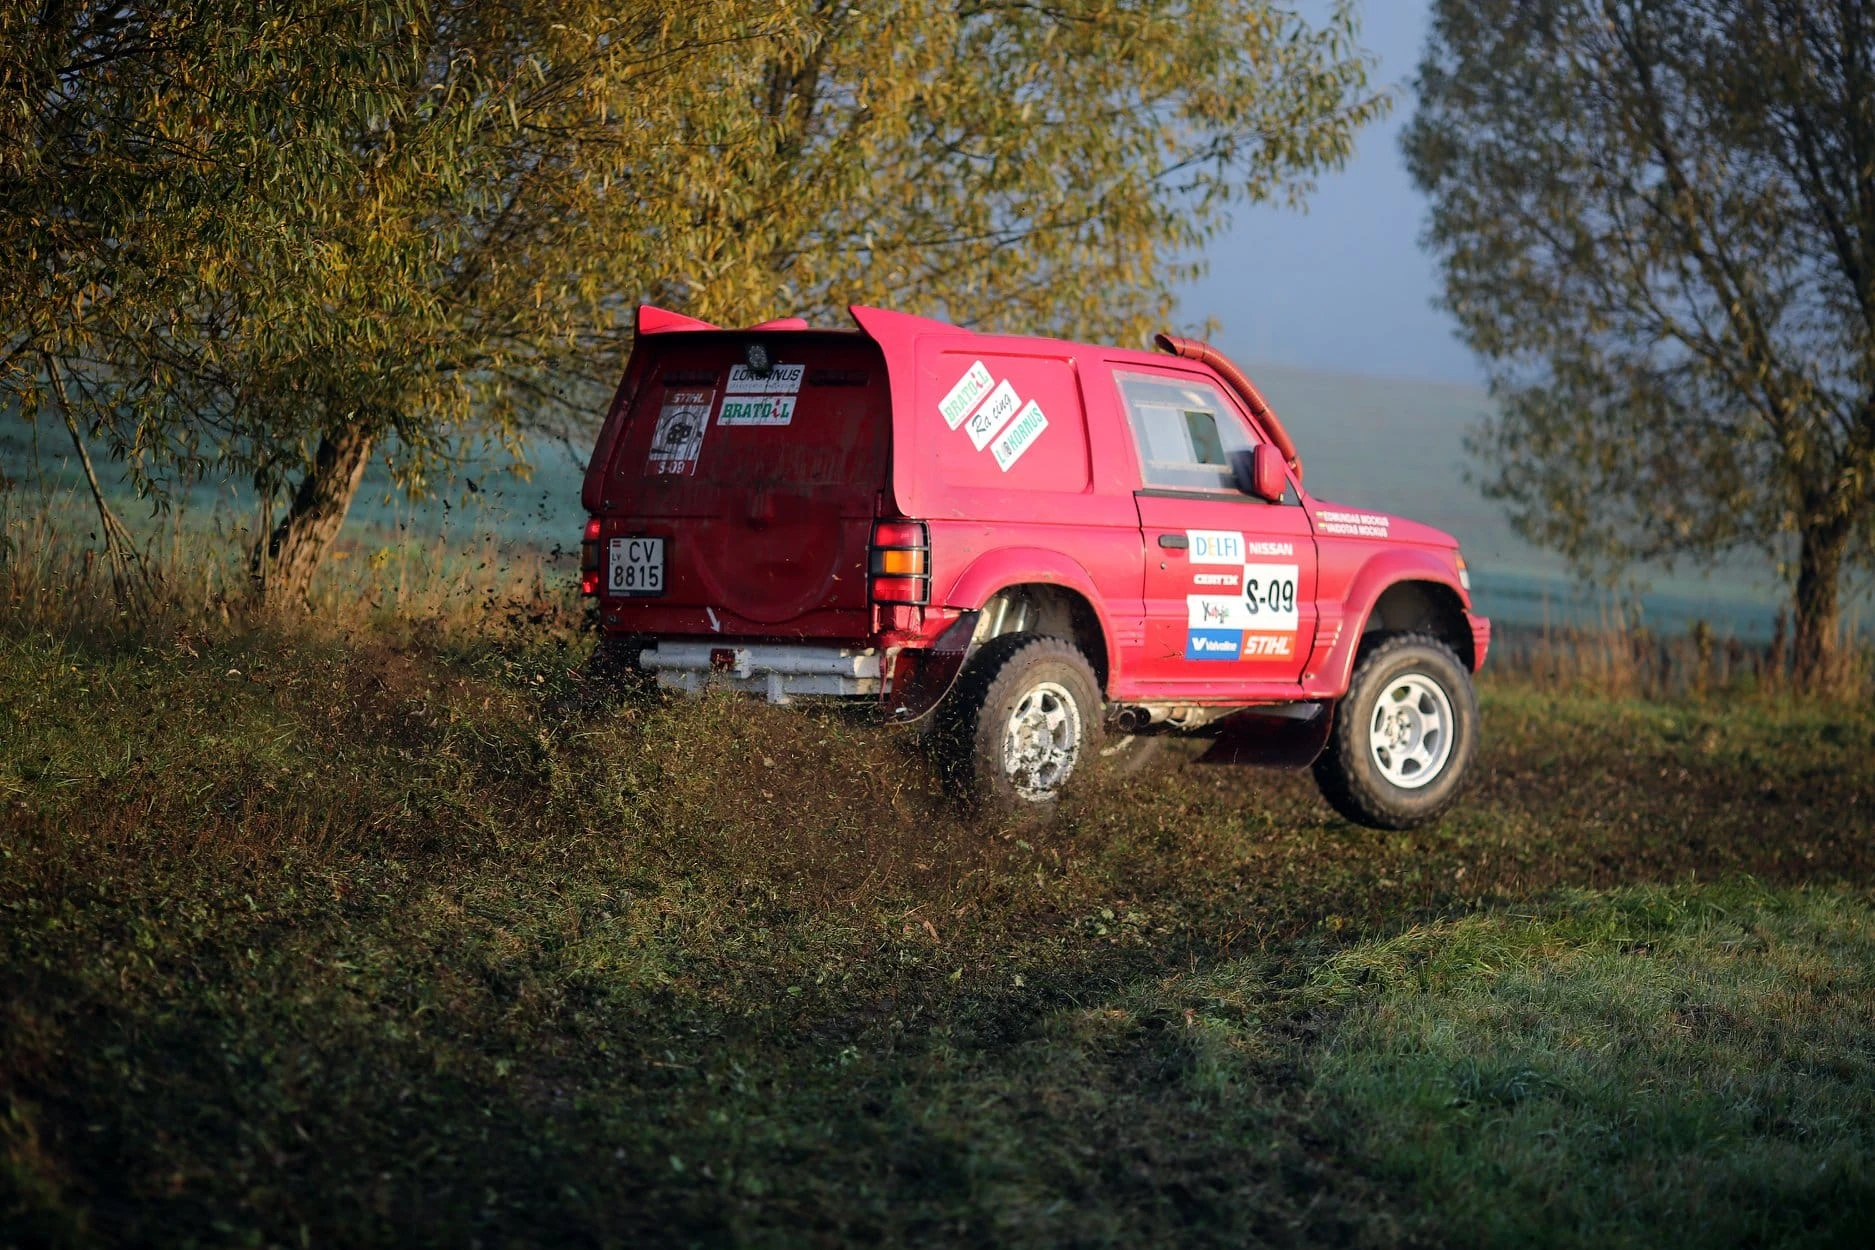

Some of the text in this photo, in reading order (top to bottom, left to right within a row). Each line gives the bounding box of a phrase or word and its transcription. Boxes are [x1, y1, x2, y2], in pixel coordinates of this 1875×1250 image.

[630, 541, 655, 563] CV
[1196, 536, 1237, 557] DELFI
[1249, 542, 1293, 556] NISSAN
[614, 565, 659, 587] 8815
[1245, 579, 1294, 614] S-09
[1244, 636, 1290, 655] STIHL
